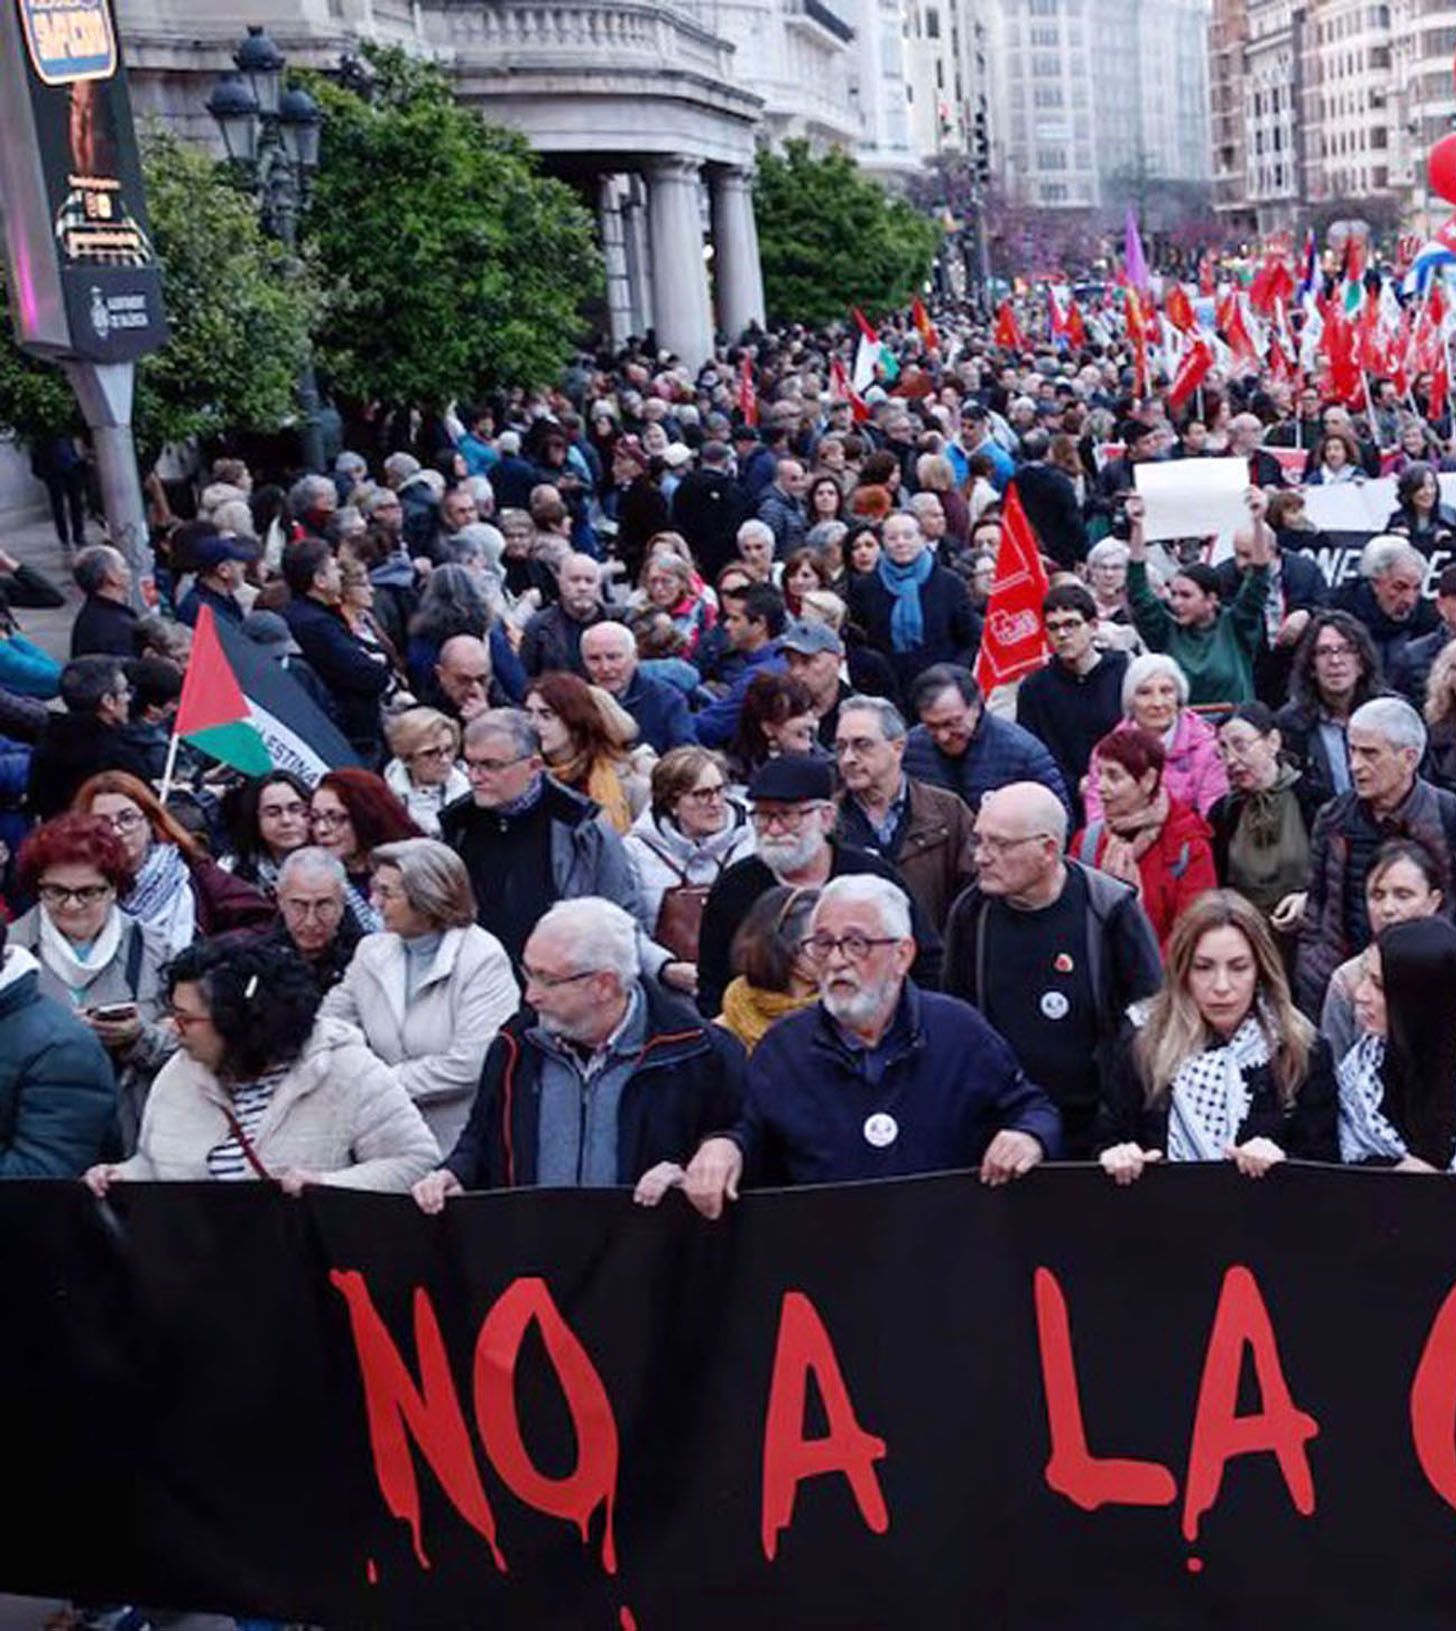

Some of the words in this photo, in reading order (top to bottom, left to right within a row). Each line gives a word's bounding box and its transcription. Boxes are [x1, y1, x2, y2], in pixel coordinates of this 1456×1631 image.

[331, 1271, 617, 1573] NO
[763, 1292, 887, 1559] A
[1035, 1267, 1318, 1541] LA
